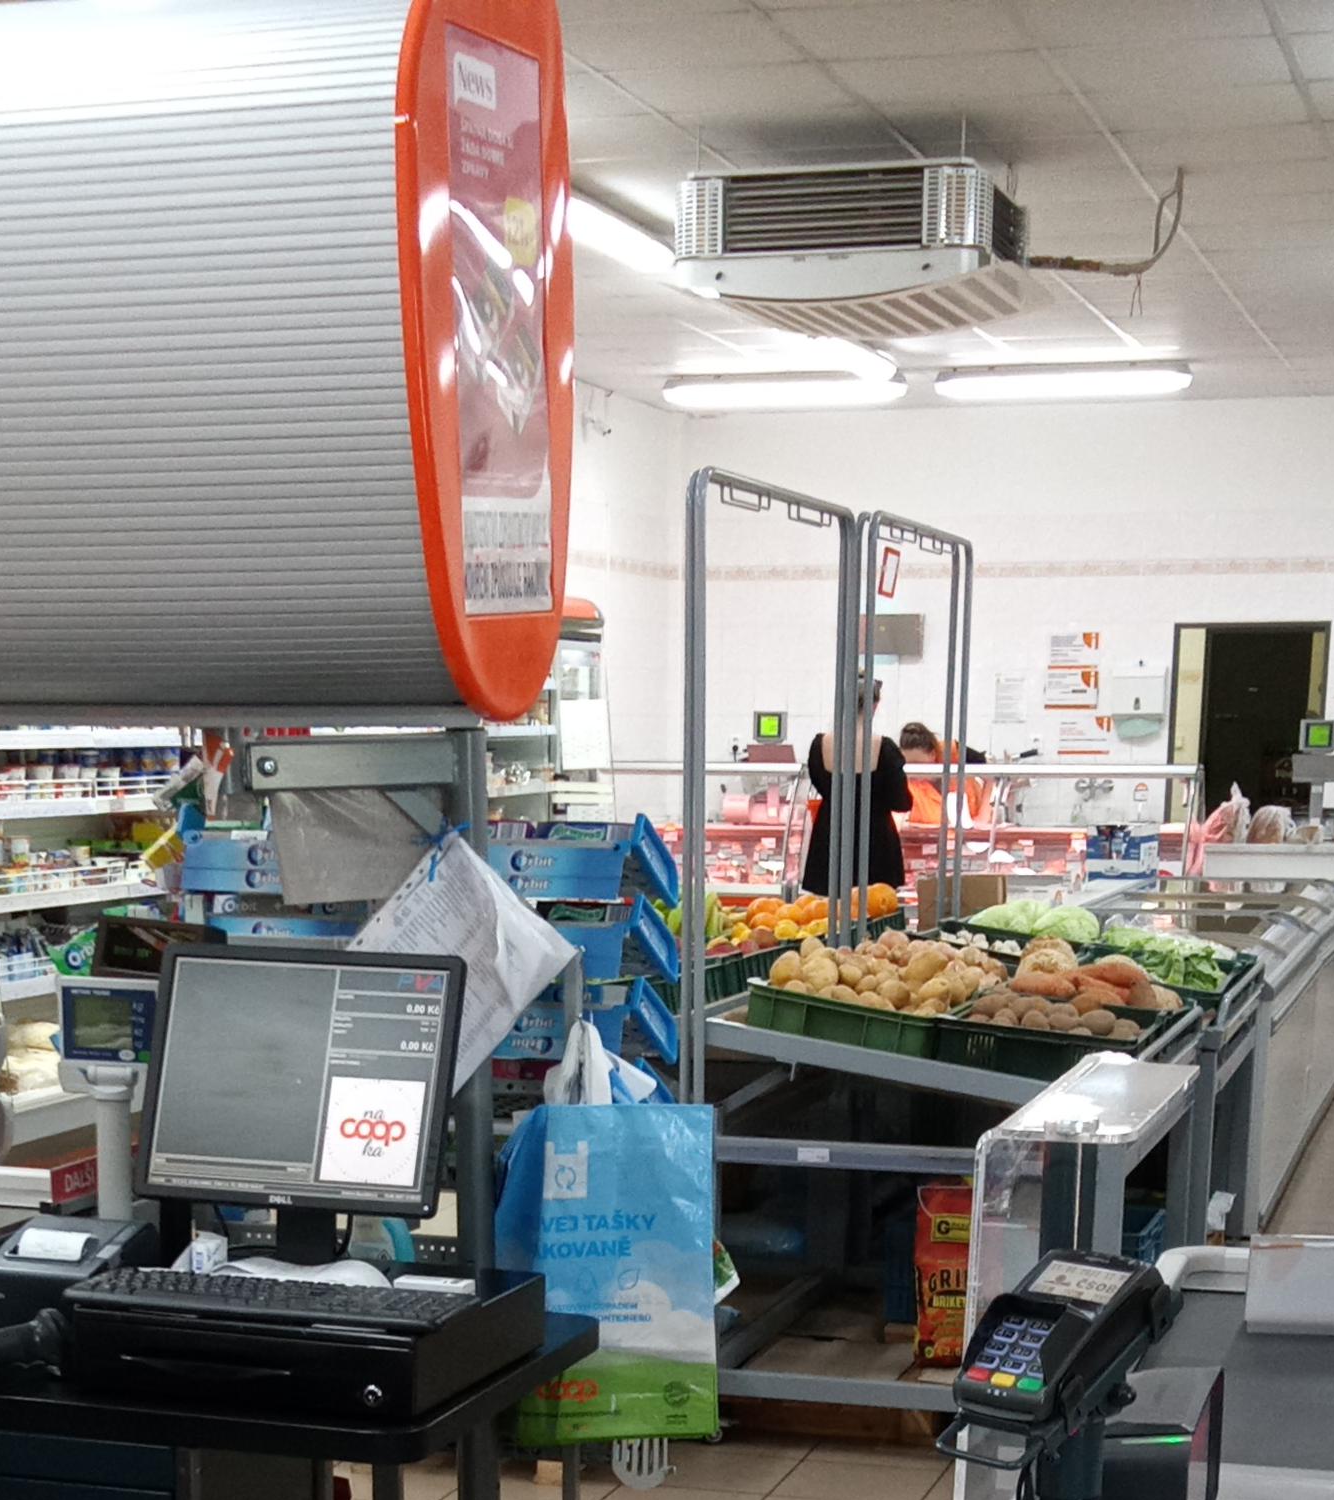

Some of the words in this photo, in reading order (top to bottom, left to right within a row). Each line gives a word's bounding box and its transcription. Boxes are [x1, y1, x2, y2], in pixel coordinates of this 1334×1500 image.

[457, 60, 494, 99] News
[363, 1109, 384, 1120] na
[339, 1118, 406, 1147] coop
[362, 1138, 383, 1158] ka
[64, 1168, 95, 1193] DALŠÍ
[268, 1195, 293, 1205] DELL
[582, 1208, 657, 1233] TAŠKY
[1075, 1277, 1118, 1294] ČSOB
